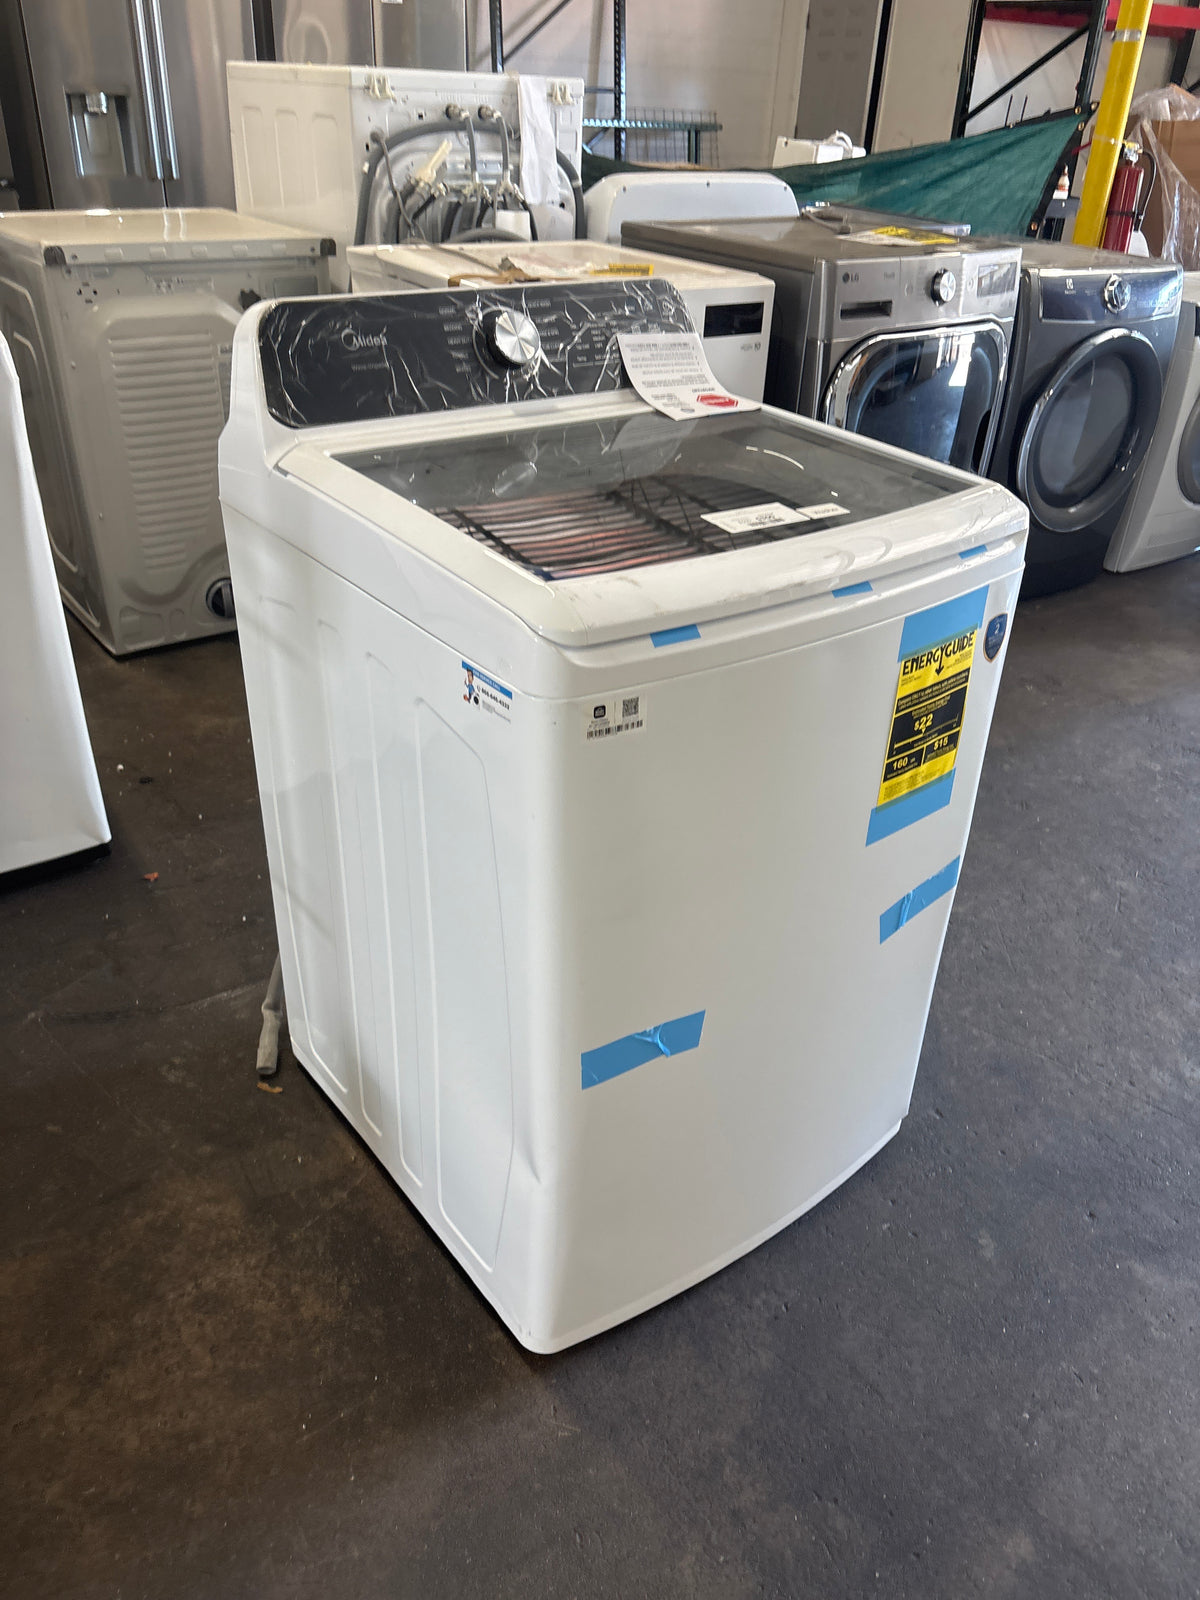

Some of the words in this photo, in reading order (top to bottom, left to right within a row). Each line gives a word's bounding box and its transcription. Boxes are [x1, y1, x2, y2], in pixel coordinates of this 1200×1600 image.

[346, 329, 388, 350] Midea
[903, 632, 975, 675] ENERGYGUIDE
[914, 713, 933, 731] $22
